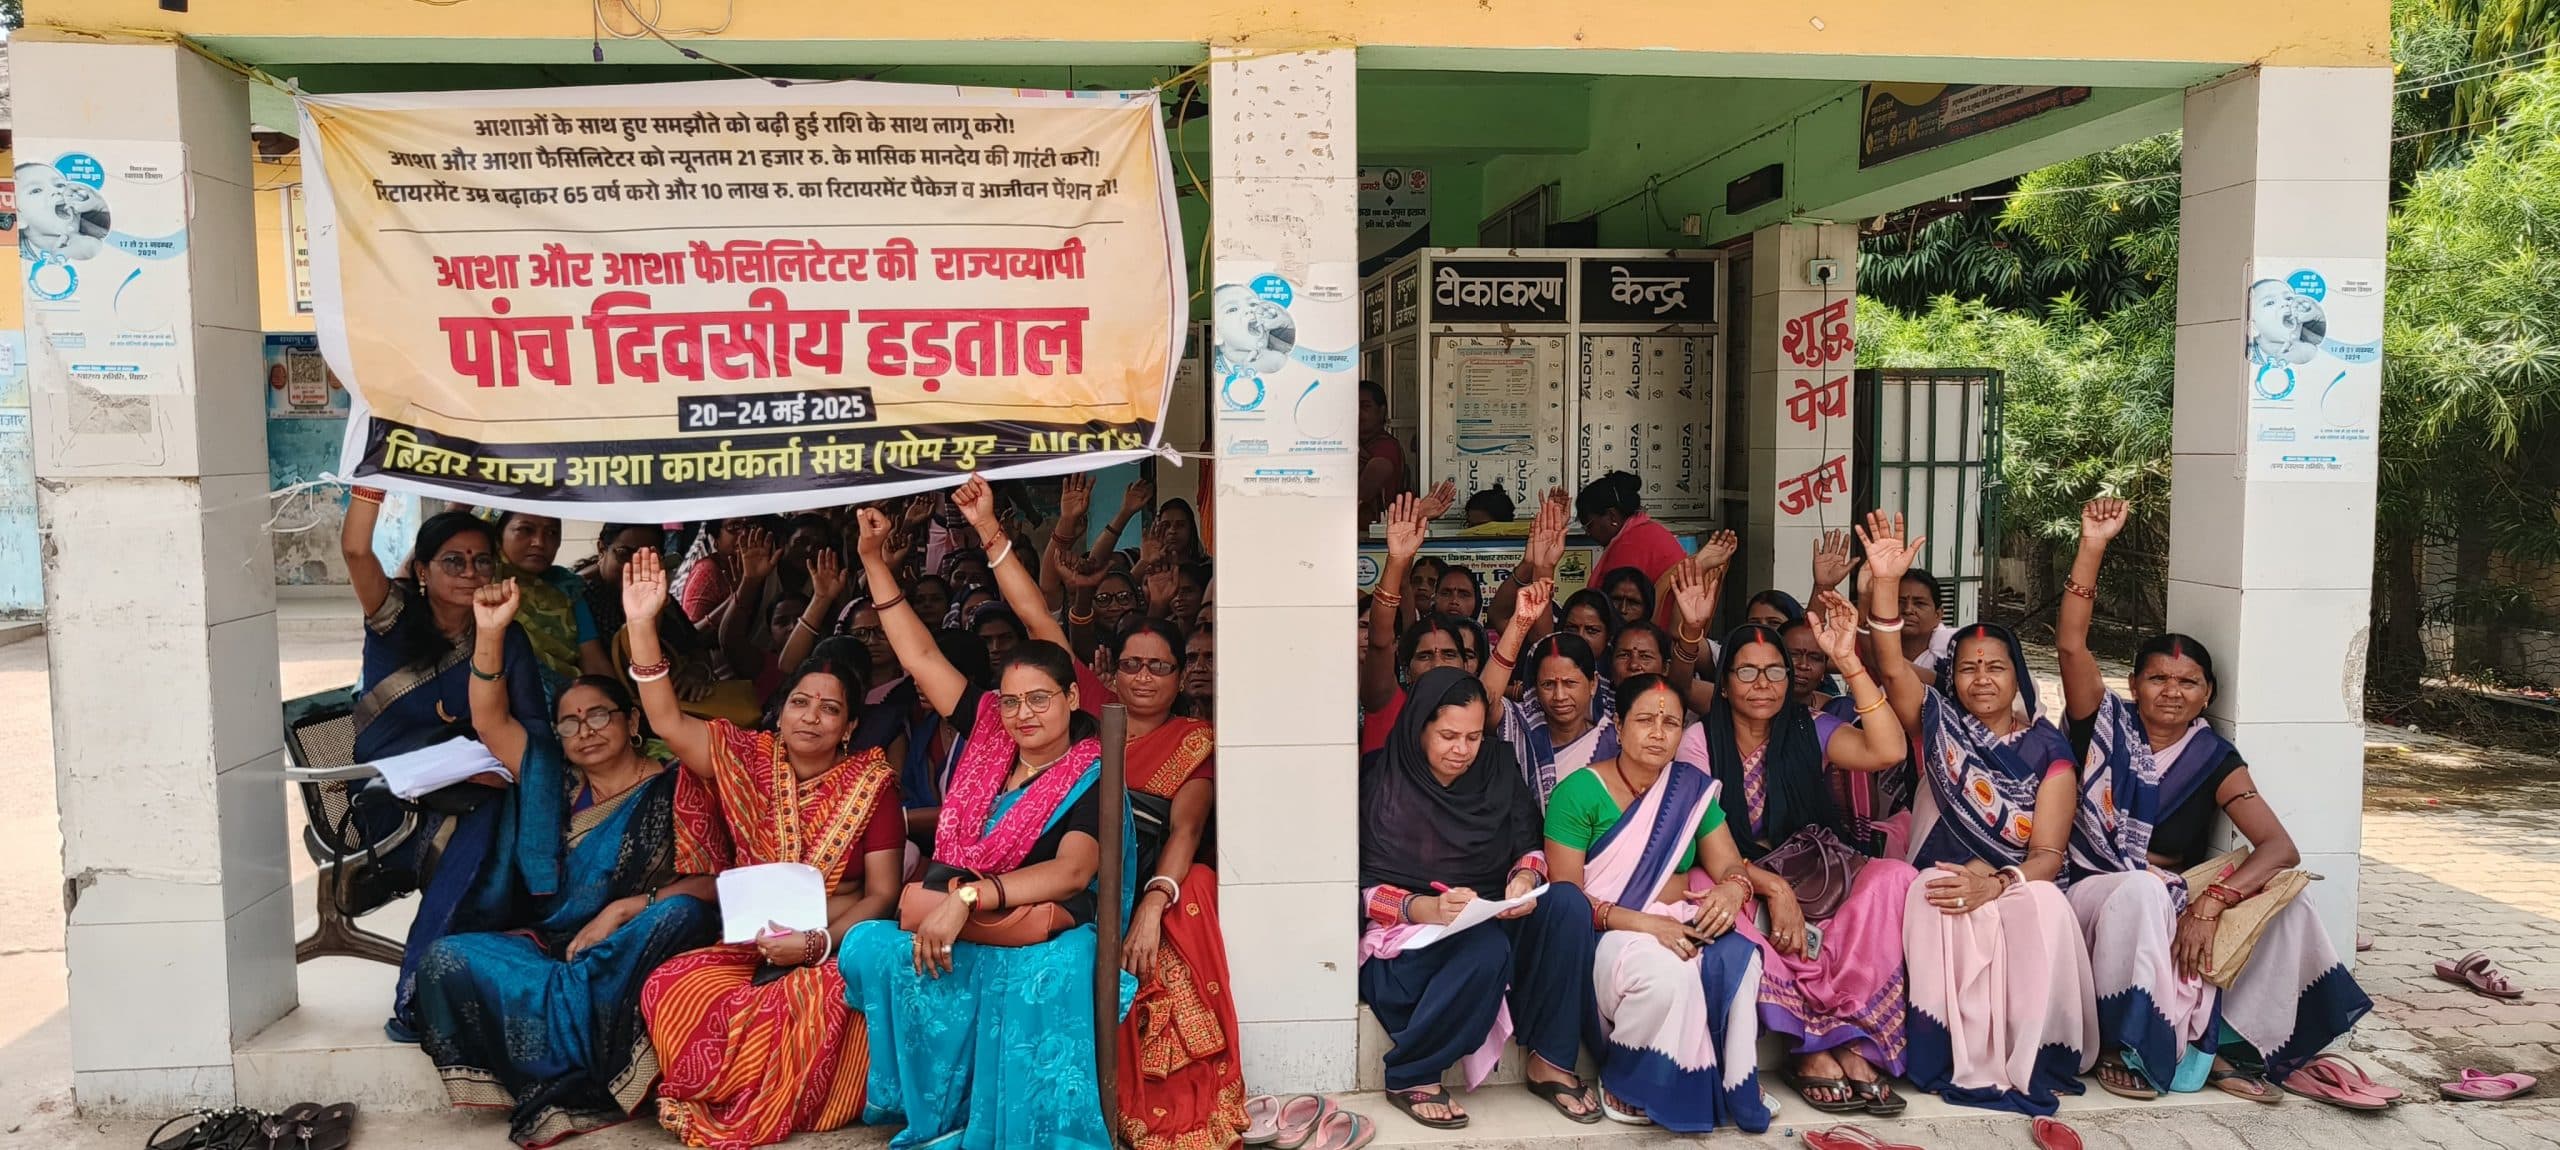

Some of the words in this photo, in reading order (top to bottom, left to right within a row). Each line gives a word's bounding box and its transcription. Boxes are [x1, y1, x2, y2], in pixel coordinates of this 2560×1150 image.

[474, 112, 549, 136] आशाओं
[556, 113, 573, 135] के
[578, 117, 615, 135] साथ
[624, 117, 647, 141] हुए
[654, 112, 720, 134] समझौते
[726, 112, 750, 134] को
[757, 112, 790, 136] बढ़ी
[795, 112, 820, 140] हुई
[824, 113, 863, 134] राशि
[868, 112, 886, 134] के
[890, 116, 927, 133] साथ
[934, 117, 969, 140] लागू
[974, 113, 1016, 134] करो!
[389, 150, 437, 170] आशा
[443, 147, 477, 170] और
[483, 152, 532, 171] आशा
[538, 147, 635, 171] फैसिलिटेटर
[640, 146, 665, 168] को
[671, 149, 731, 174] न्यूनतम
[738, 151, 756, 167] 21
[761, 149, 803, 167] हजार
[810, 149, 829, 169] रु.
[833, 146, 852, 167] के
[857, 145, 916, 166] मासिक
[922, 145, 980, 168] मानदेय
[985, 145, 1009, 167] की
[1013, 146, 1057, 169] गारंटी
[1062, 147, 1101, 168] करो!
[373, 180, 459, 202] रिटायरमेंट
[465, 185, 489, 203] उम्र
[494, 186, 557, 208] बढ़ाकर
[564, 186, 587, 204] 65
[592, 179, 621, 203] वर्ष
[626, 180, 661, 202] करो
[666, 179, 697, 201] और
[701, 183, 722, 200] 10
[729, 182, 769, 200] लाख
[774, 183, 794, 201] रु.
[799, 182, 822, 200] का
[827, 177, 906, 198] रिटायरमेंट
[911, 177, 957, 198] पैकेज
[962, 182, 974, 198] व
[980, 178, 1048, 199] आजीवन
[1053, 178, 1091, 200] पेंशन
[433, 255, 520, 290] आशा
[529, 242, 593, 289] और
[603, 251, 687, 288] आशा
[690, 238, 869, 285] फैसिलिटेटर
[874, 237, 917, 283] की
[931, 237, 1086, 281] राज्यव्यापी
[1436, 266, 1564, 313] टीकाकरण
[1611, 266, 1690, 315] केन्द्र
[439, 296, 573, 388] पांच
[582, 288, 850, 384] दिवसीय
[859, 307, 1090, 393] हड़ताल
[1782, 298, 1854, 368] शुद्ध
[773, 394, 806, 424] मई
[811, 396, 867, 420] 2025
[1786, 375, 1848, 431] पेय
[383, 431, 469, 477] बिहार
[477, 455, 557, 487] राज्य
[565, 453, 653, 487] आशा
[660, 441, 802, 484] कार्यकर्ता
[810, 434, 865, 476] संघ
[1779, 454, 1846, 516] जल
